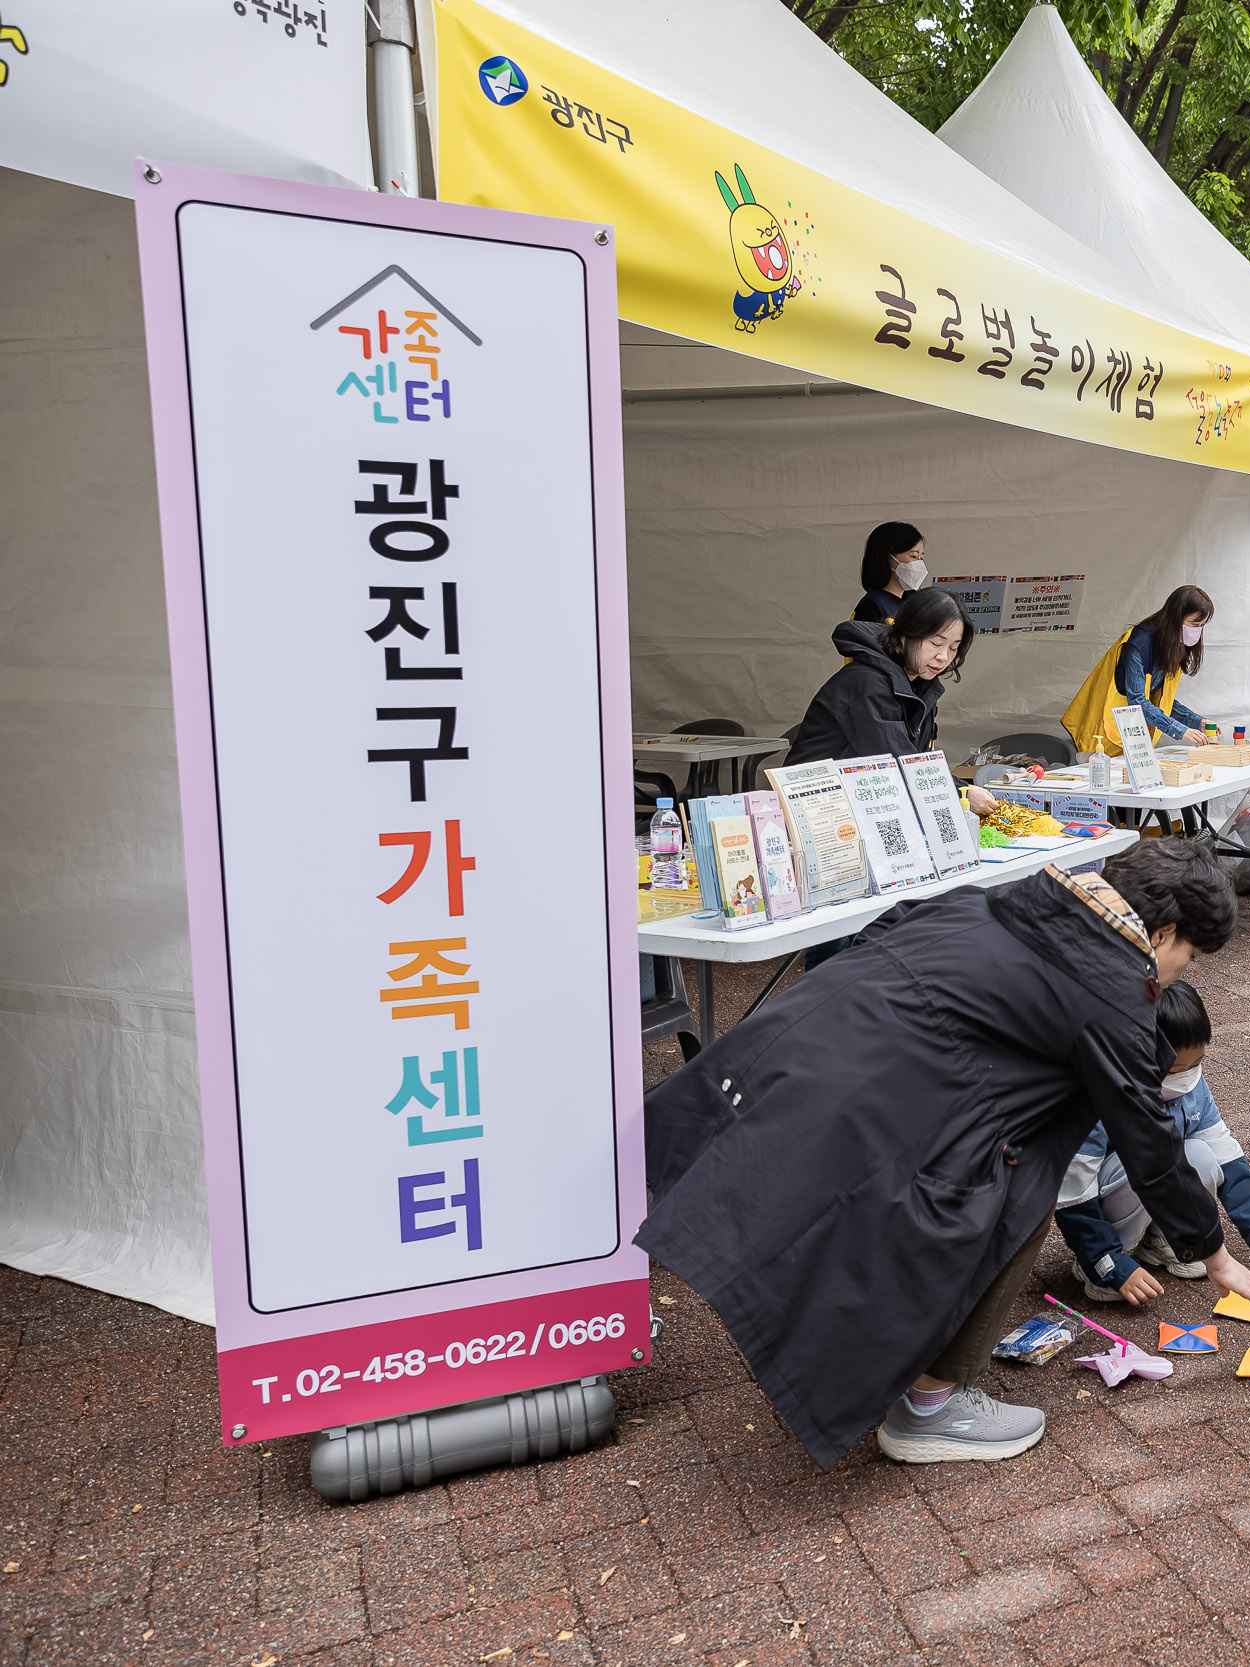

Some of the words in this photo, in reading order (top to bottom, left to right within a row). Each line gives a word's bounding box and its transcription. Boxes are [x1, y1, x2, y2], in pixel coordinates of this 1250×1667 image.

[540, 84, 634, 153] 광진구
[338, 309, 441, 381] 가족
[336, 360, 451, 424] 센터
[252, 1312, 626, 1405] T.02-458-0622/0666
